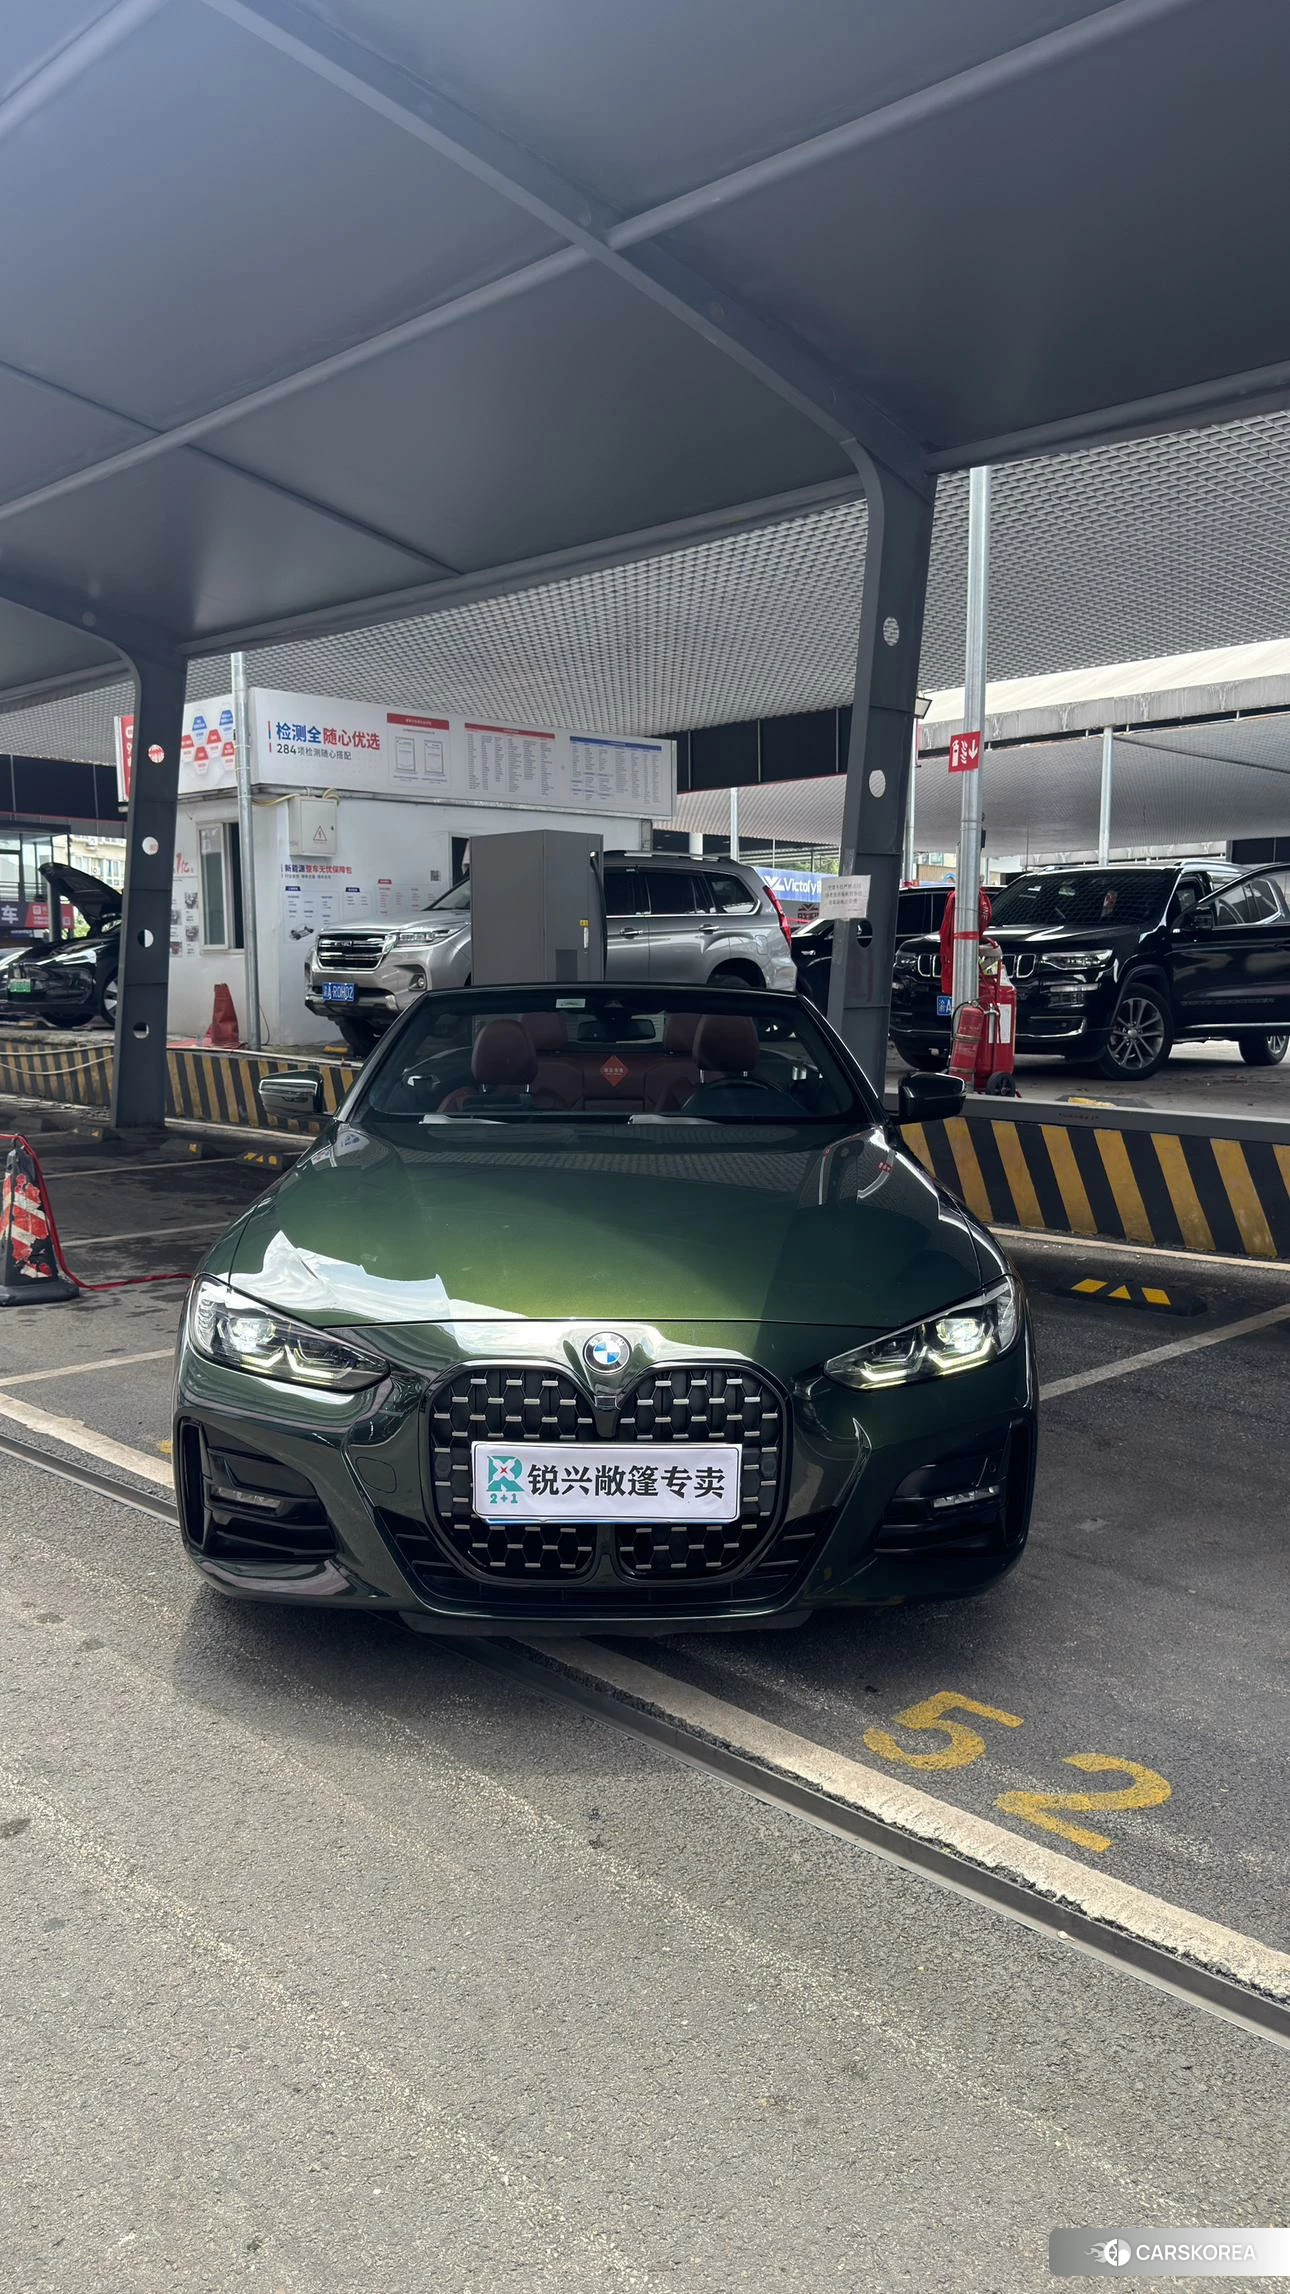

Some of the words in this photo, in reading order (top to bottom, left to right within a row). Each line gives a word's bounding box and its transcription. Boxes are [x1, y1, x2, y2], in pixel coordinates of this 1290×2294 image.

[276, 722, 380, 750] 检测全随心优选
[527, 1464, 726, 1499] 锐兴敞篷专卖
[490, 1494, 518, 1504] 2+1
